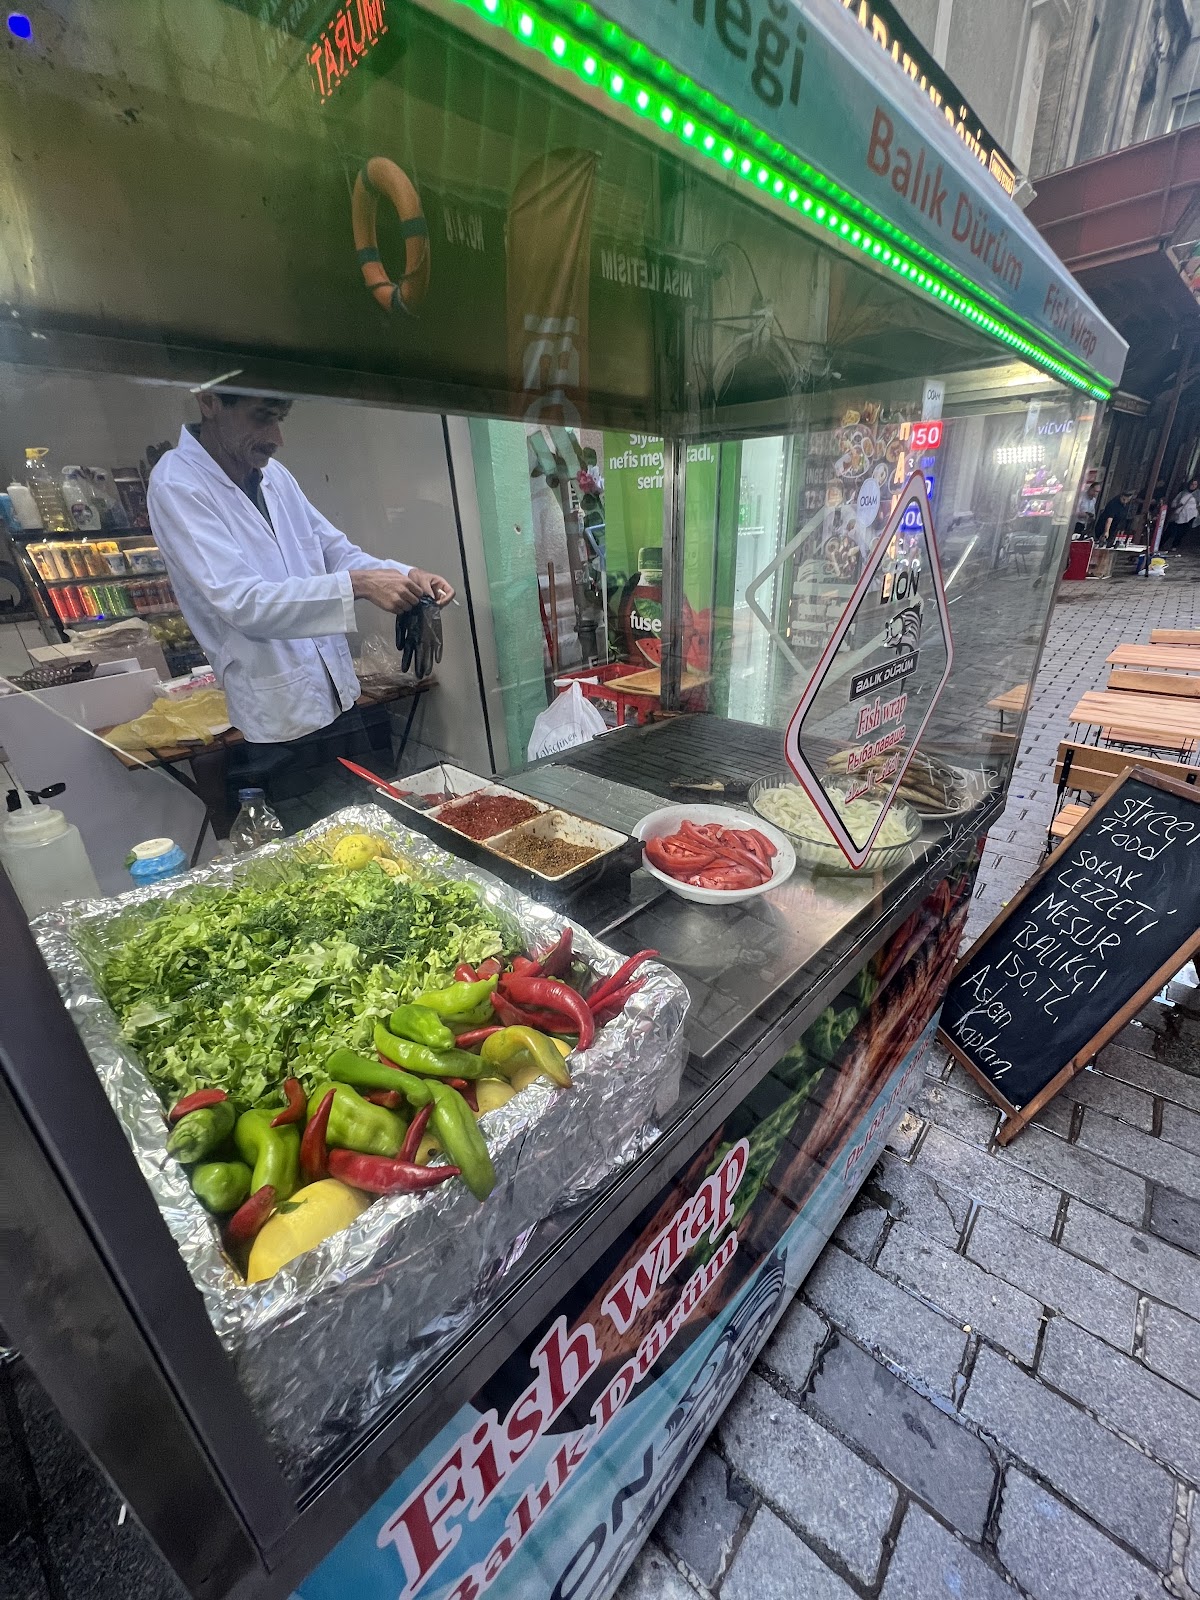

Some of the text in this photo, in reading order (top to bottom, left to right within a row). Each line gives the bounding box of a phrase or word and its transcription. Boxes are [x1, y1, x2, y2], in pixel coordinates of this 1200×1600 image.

[692, 0, 807, 109] eği
[867, 105, 948, 228] Balık
[951, 191, 1023, 291] Dürüm
[1042, 283, 1069, 330] Fish
[911, 426, 941, 447] 50
[609, 450, 639, 470] nefis
[640, 452, 664, 470] mey
[880, 571, 920, 605] LION
[629, 610, 662, 633] fuse
[855, 658, 914, 694] BALIK DÜRÜM
[856, 693, 908, 739] Fish wrap
[1071, 850, 1143, 892] SOKAK
[960, 964, 1013, 1030] Aslan
[377, 1137, 750, 1596] Fish wrap
[440, 1230, 740, 1600] Balık Dürüm
